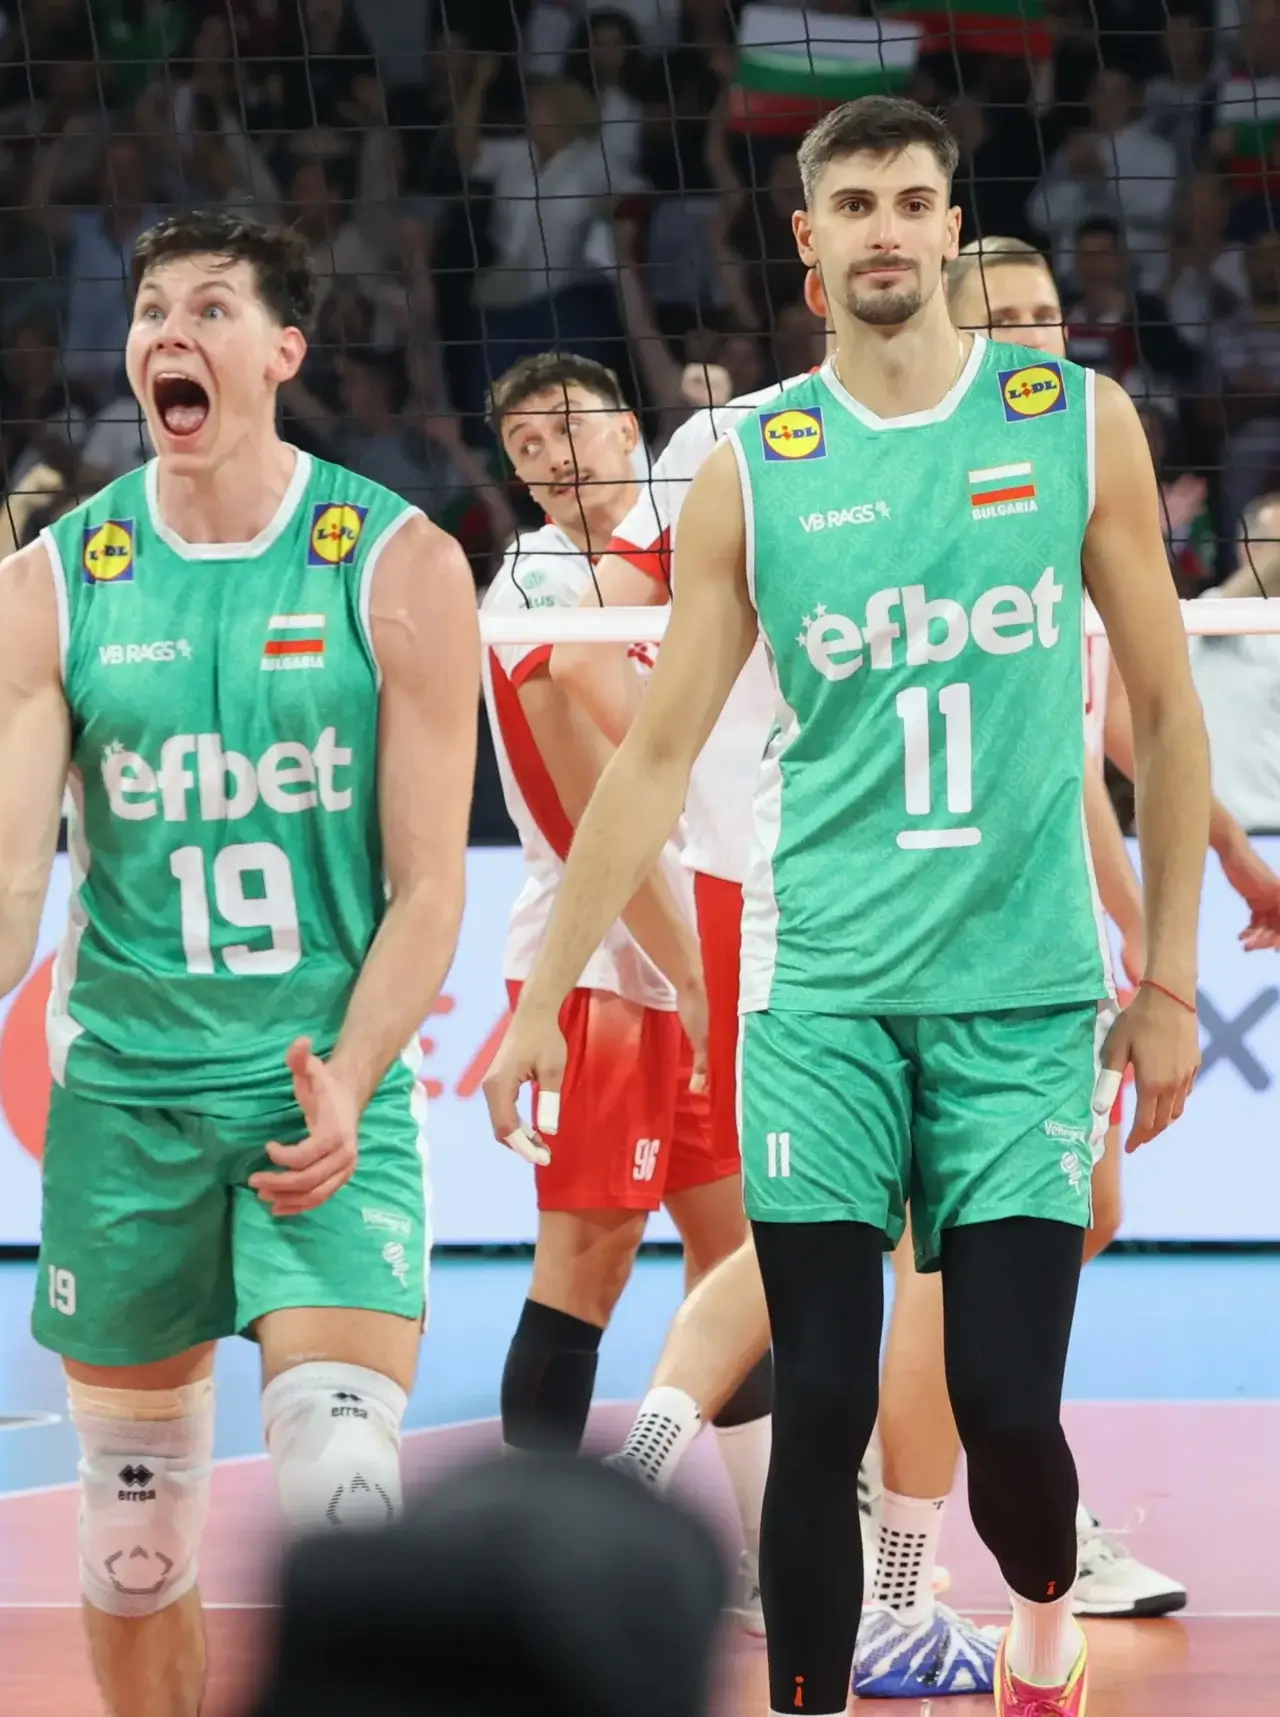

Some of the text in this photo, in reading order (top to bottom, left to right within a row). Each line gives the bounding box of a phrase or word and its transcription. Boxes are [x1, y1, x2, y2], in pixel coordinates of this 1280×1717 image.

[971, 500, 1038, 521] BULGARIA
[800, 566, 1064, 682] efbet
[101, 726, 353, 822] efbet
[895, 682, 973, 815] 11
[169, 841, 303, 976] 19
[766, 1132, 790, 1178] 11
[48, 1264, 76, 1316] 19
